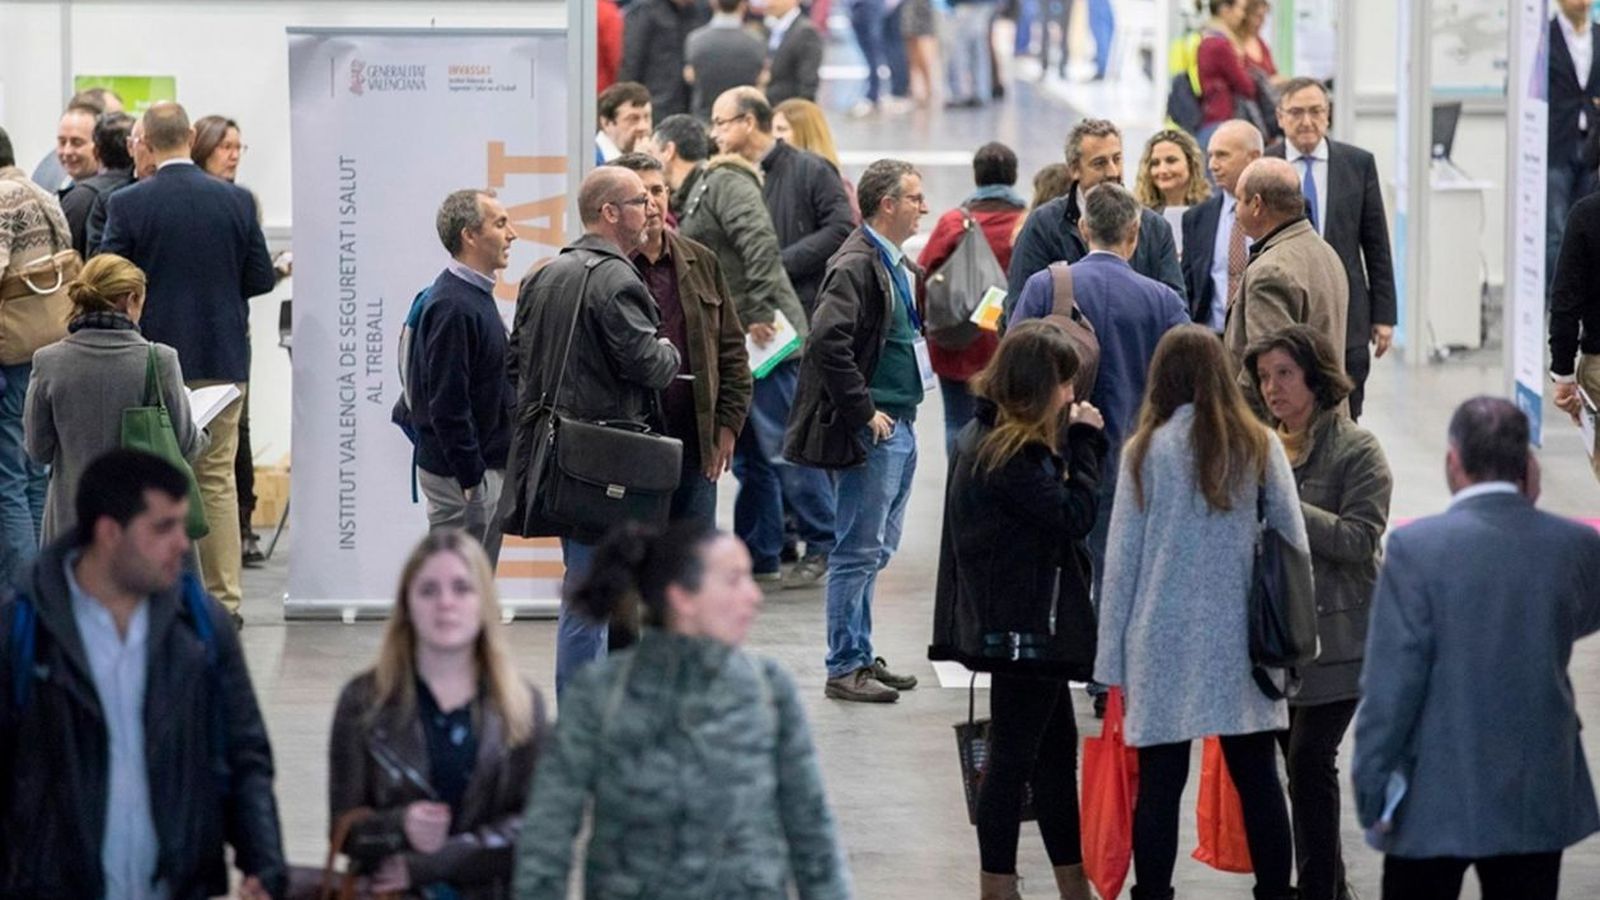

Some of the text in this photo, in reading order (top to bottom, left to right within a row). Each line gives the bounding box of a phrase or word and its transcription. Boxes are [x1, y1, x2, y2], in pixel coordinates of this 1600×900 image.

[366, 65, 427, 78] GENERALITAT
[368, 79, 428, 91] VALENCIANA
[338, 155, 356, 215] SALUT
[338, 230, 356, 337] SEGURETAT
[338, 342, 356, 366] DE
[365, 297, 382, 404] AL TREBALL
[335, 372, 356, 465] VALENCIÀ
[338, 468, 356, 550] INSTITUT
